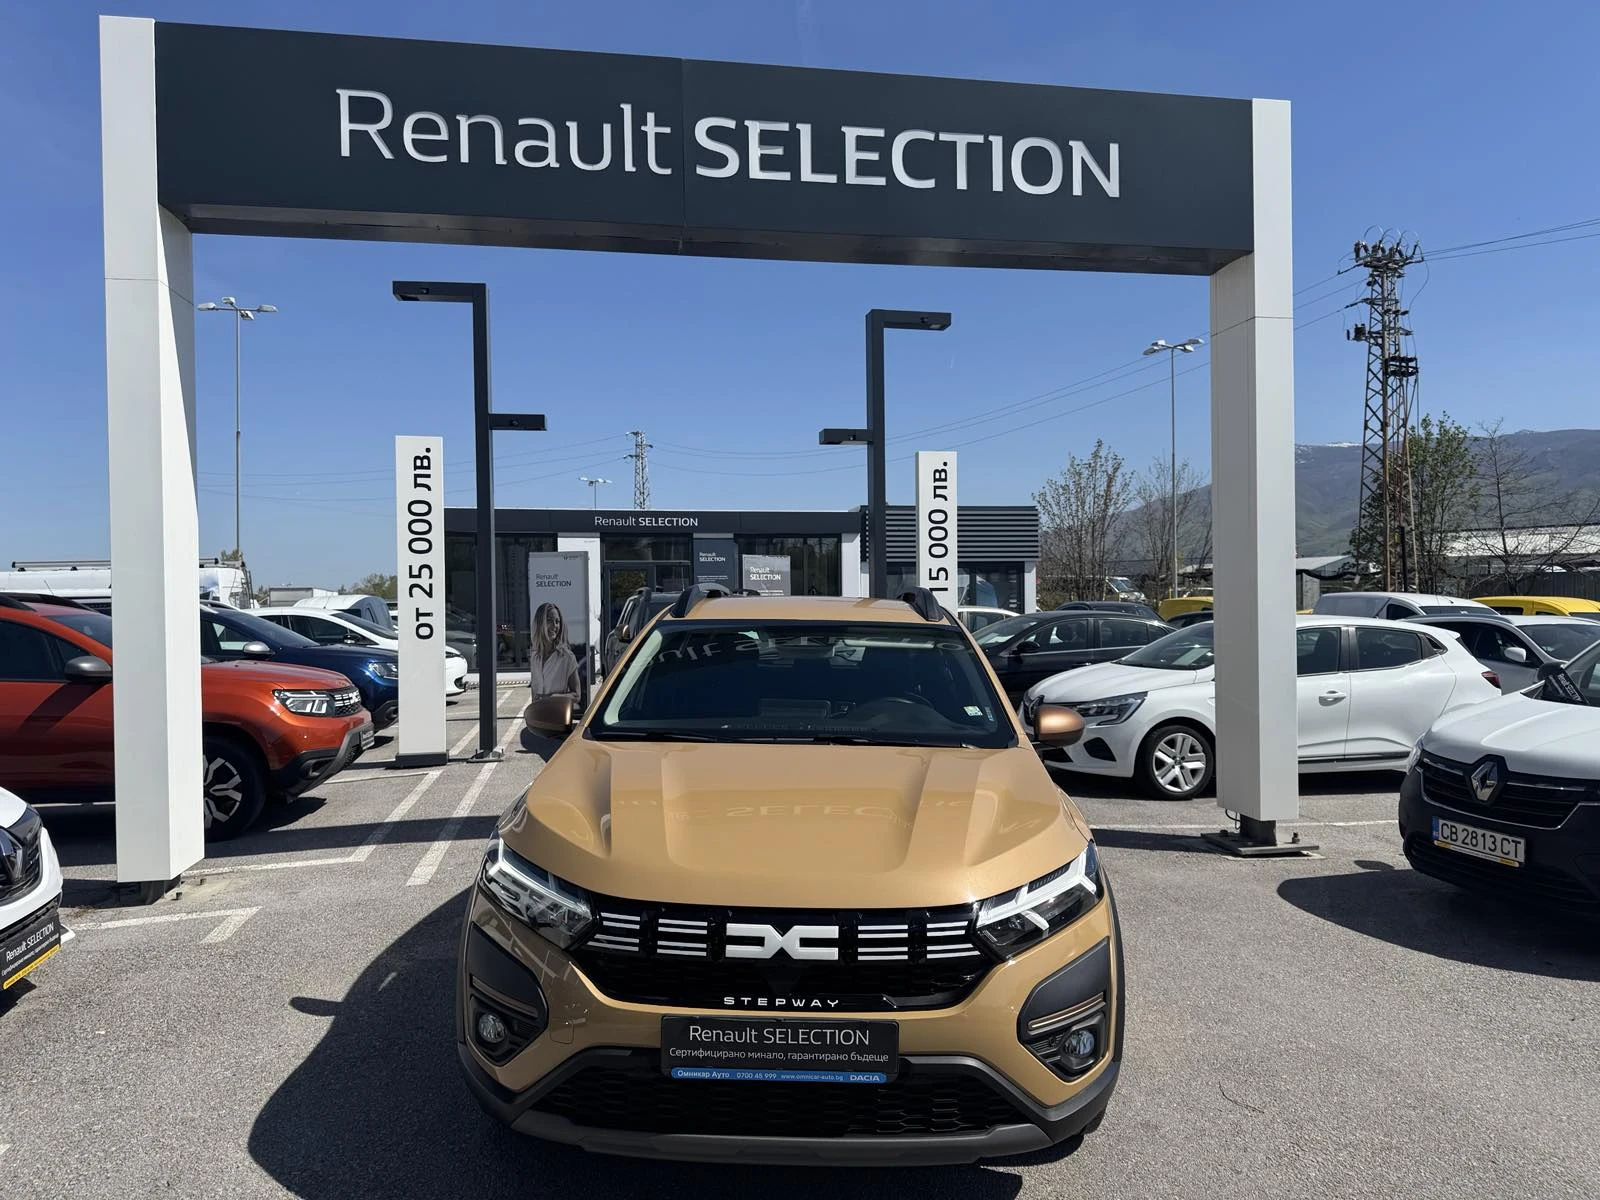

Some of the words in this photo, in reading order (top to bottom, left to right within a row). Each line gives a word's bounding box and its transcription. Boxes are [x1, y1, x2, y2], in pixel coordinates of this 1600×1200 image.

[336, 89, 672, 175] Renault
[694, 116, 1120, 198] SELECTION
[413, 447, 432, 492] лв.
[933, 461, 948, 502] лв.
[407, 499, 433, 555] 000
[594, 516, 637, 527] Renault
[638, 517, 699, 527] SELECTION
[928, 508, 949, 559] 000
[408, 564, 433, 599] 25
[535, 580, 572, 588] SELECTION
[928, 567, 949, 592] 15
[415, 607, 434, 640] от
[1440, 822, 1459, 842] CB
[1461, 828, 1498, 853] 2813
[1500, 837, 1522, 859] CT
[6, 941, 27, 962] Renault
[27, 921, 54, 948] SELECTION
[723, 996, 839, 1008] STEPWAY
[689, 1025, 759, 1043] Renault
[763, 1028, 869, 1046] SELECTION
[669, 1047, 746, 1059] Сертифицирано
[748, 1051, 786, 1060] минало,
[788, 1052, 849, 1063] гарантирано
[850, 1052, 889, 1063] бъдеще
[677, 1070, 710, 1079] Омникар
[711, 1071, 730, 1080] Ауто
[781, 1073, 844, 1081] www.omnicar-auto.bg
